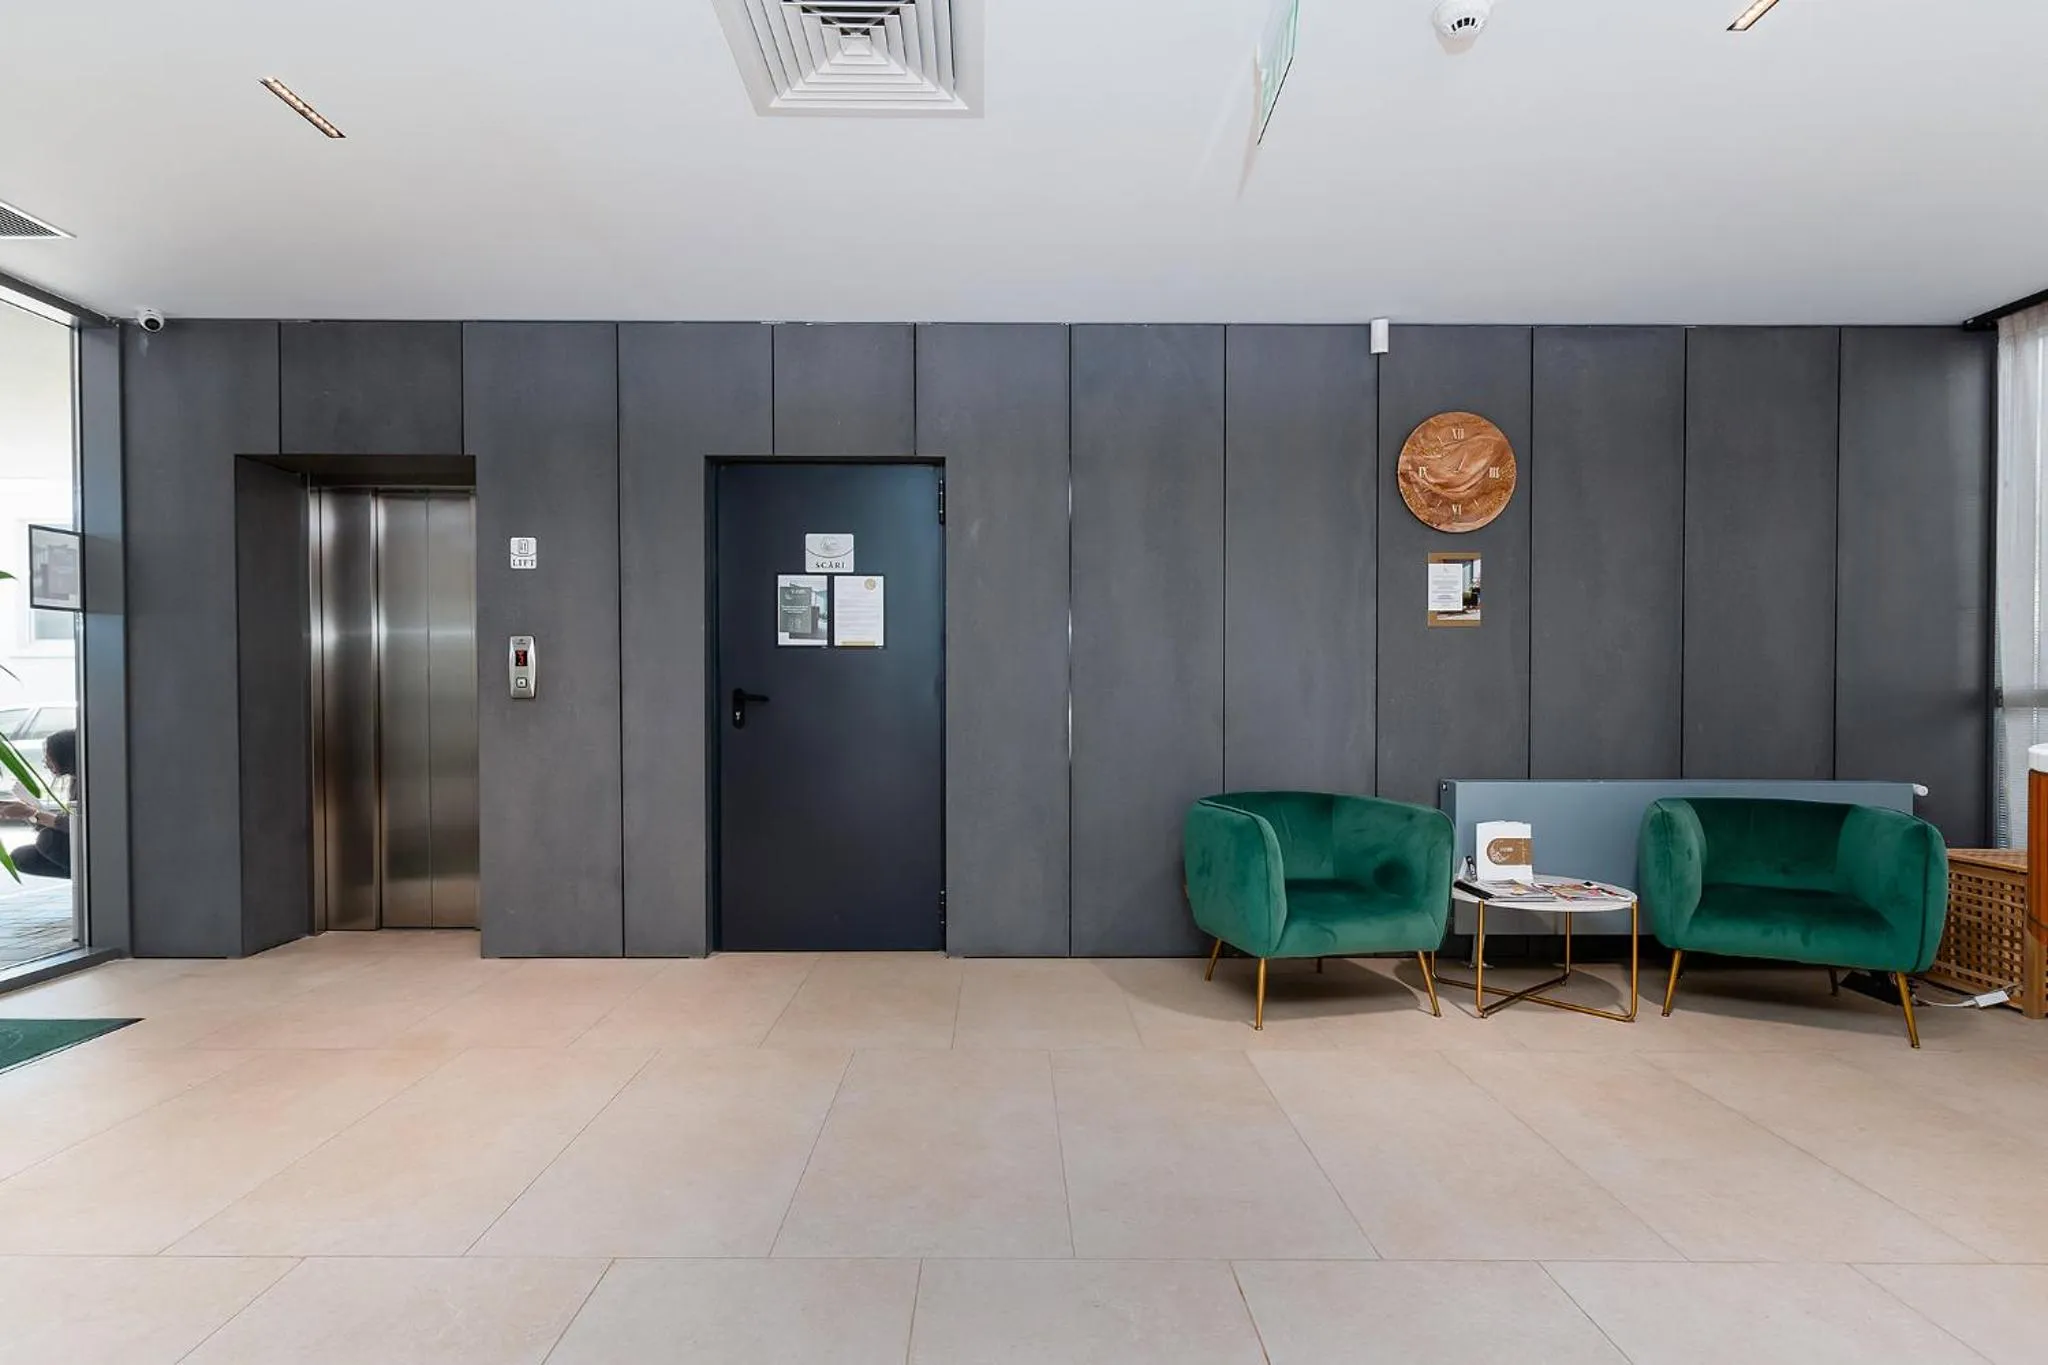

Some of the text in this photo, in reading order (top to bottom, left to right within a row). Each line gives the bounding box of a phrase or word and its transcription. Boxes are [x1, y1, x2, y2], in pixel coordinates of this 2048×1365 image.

[1452, 428, 1465, 439] XII
[1418, 466, 1428, 478] IX
[1452, 504, 1462, 515] VI
[512, 559, 535, 567] LIFT
